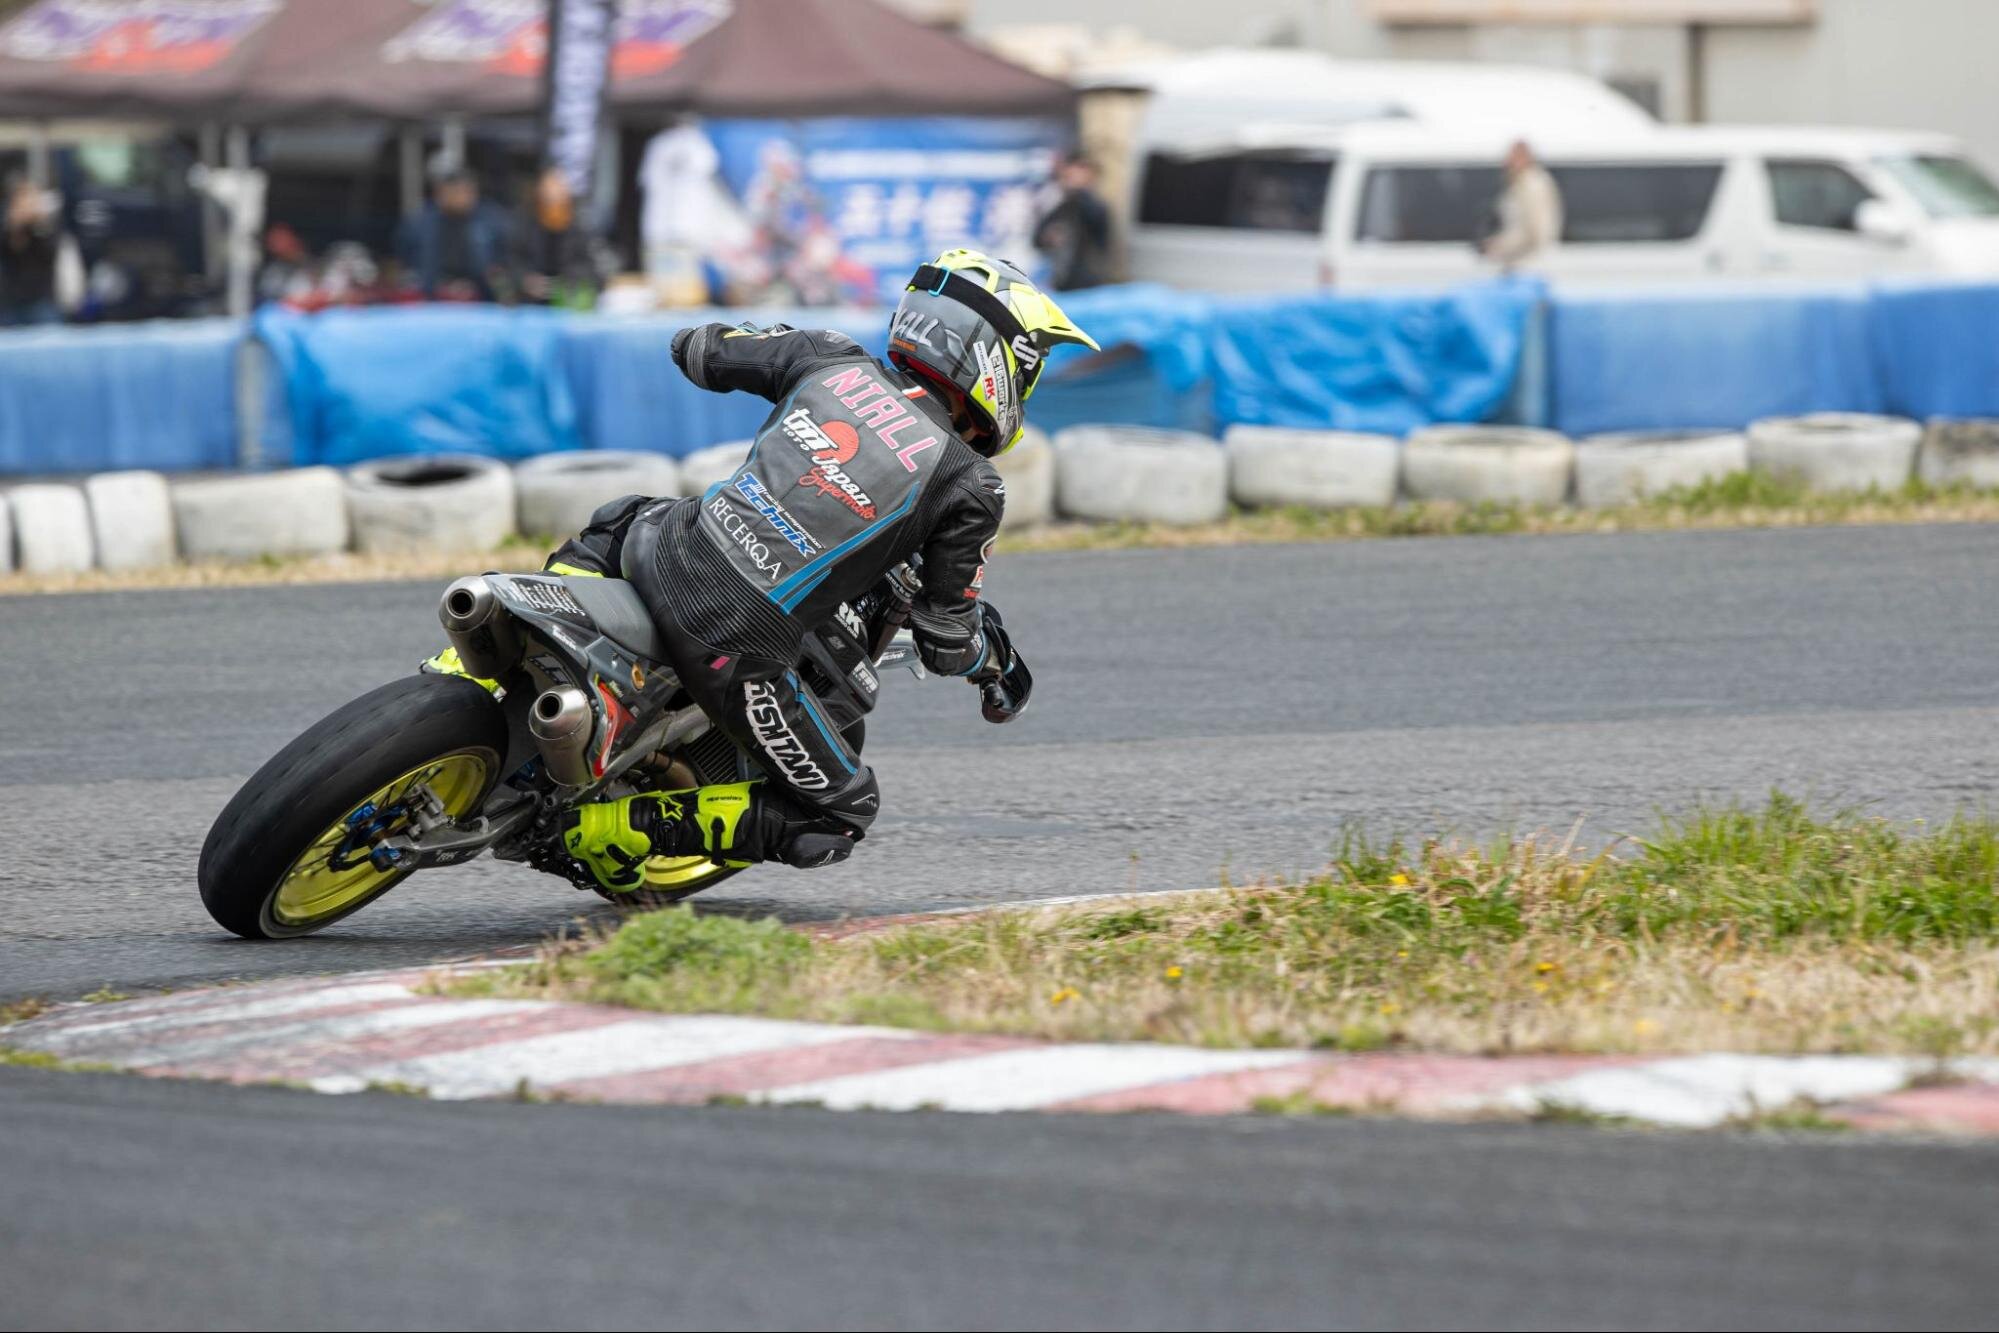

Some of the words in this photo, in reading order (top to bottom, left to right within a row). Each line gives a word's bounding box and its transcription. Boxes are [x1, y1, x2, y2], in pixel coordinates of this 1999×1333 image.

[822, 366, 938, 473] NIALL
[983, 376, 996, 401] RK
[734, 472, 817, 557] Technix
[811, 455, 872, 508] Japan
[708, 496, 785, 580] RECERQA
